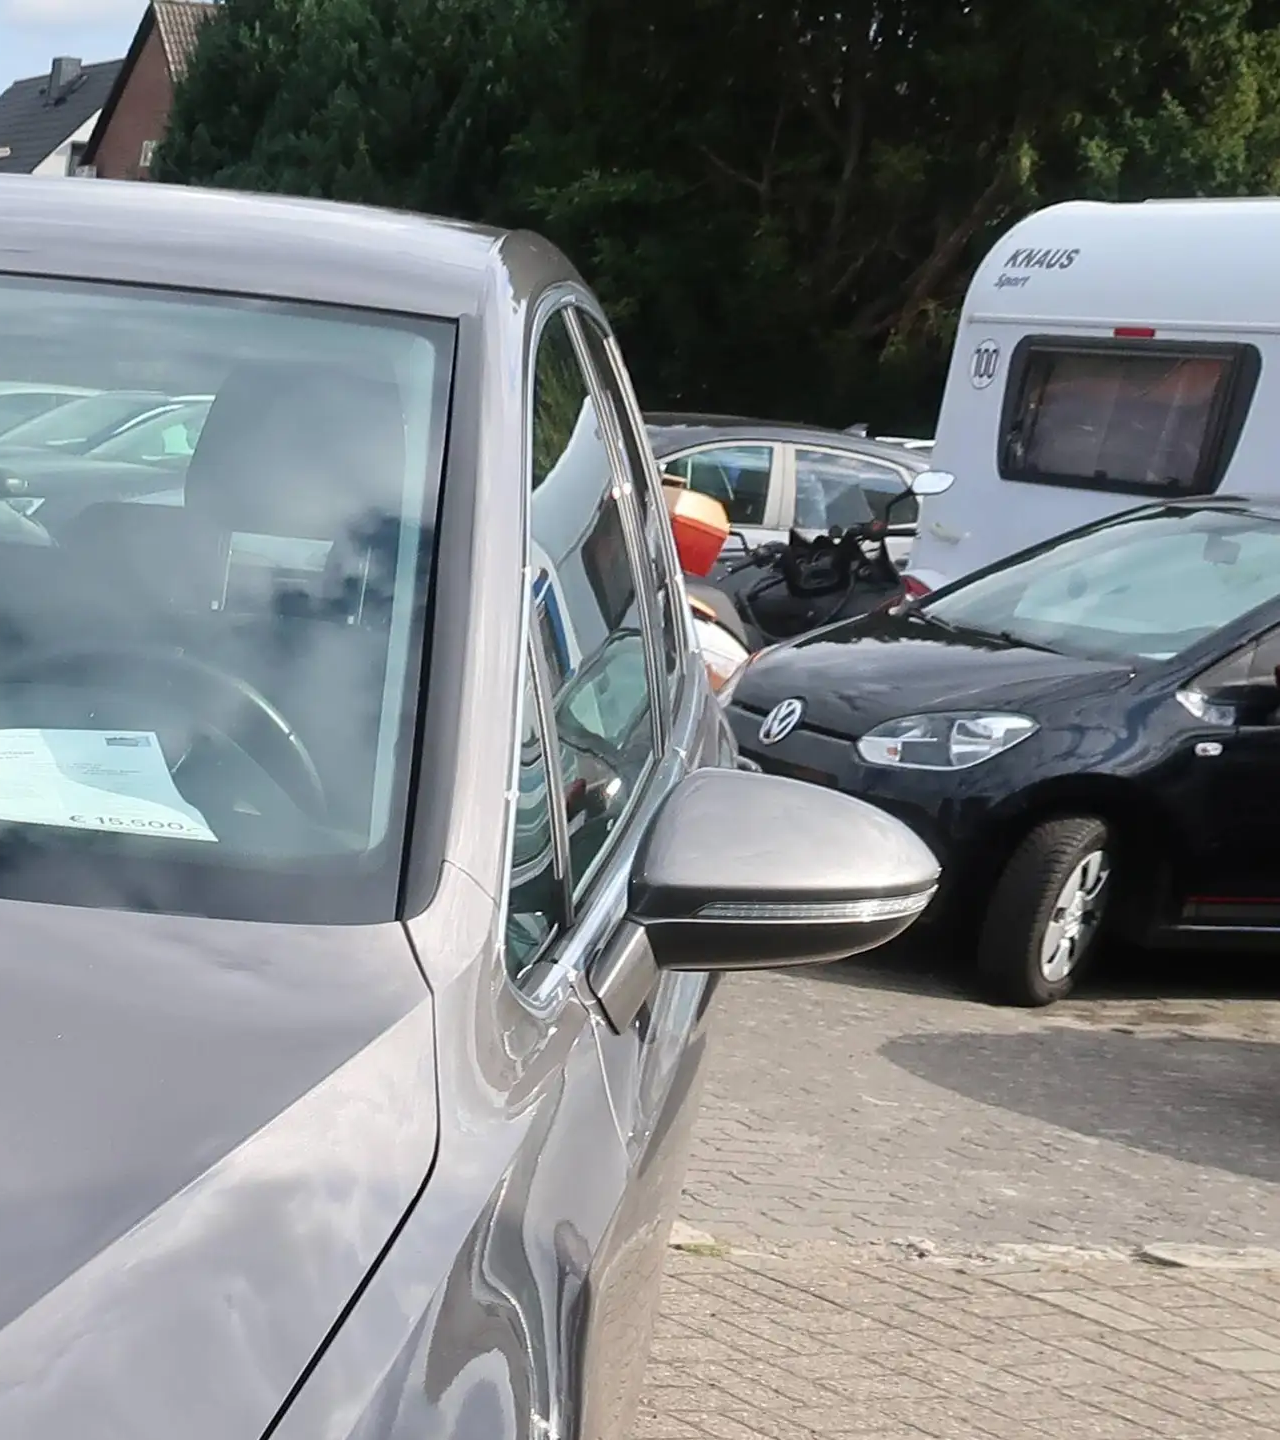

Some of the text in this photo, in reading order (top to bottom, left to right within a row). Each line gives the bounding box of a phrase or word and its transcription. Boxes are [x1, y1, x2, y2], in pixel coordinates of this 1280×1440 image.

[1004, 249, 1081, 270] KNAUS
[993, 273, 1031, 289] Sport
[973, 348, 1000, 379] 100
[69, 813, 87, 824] €
